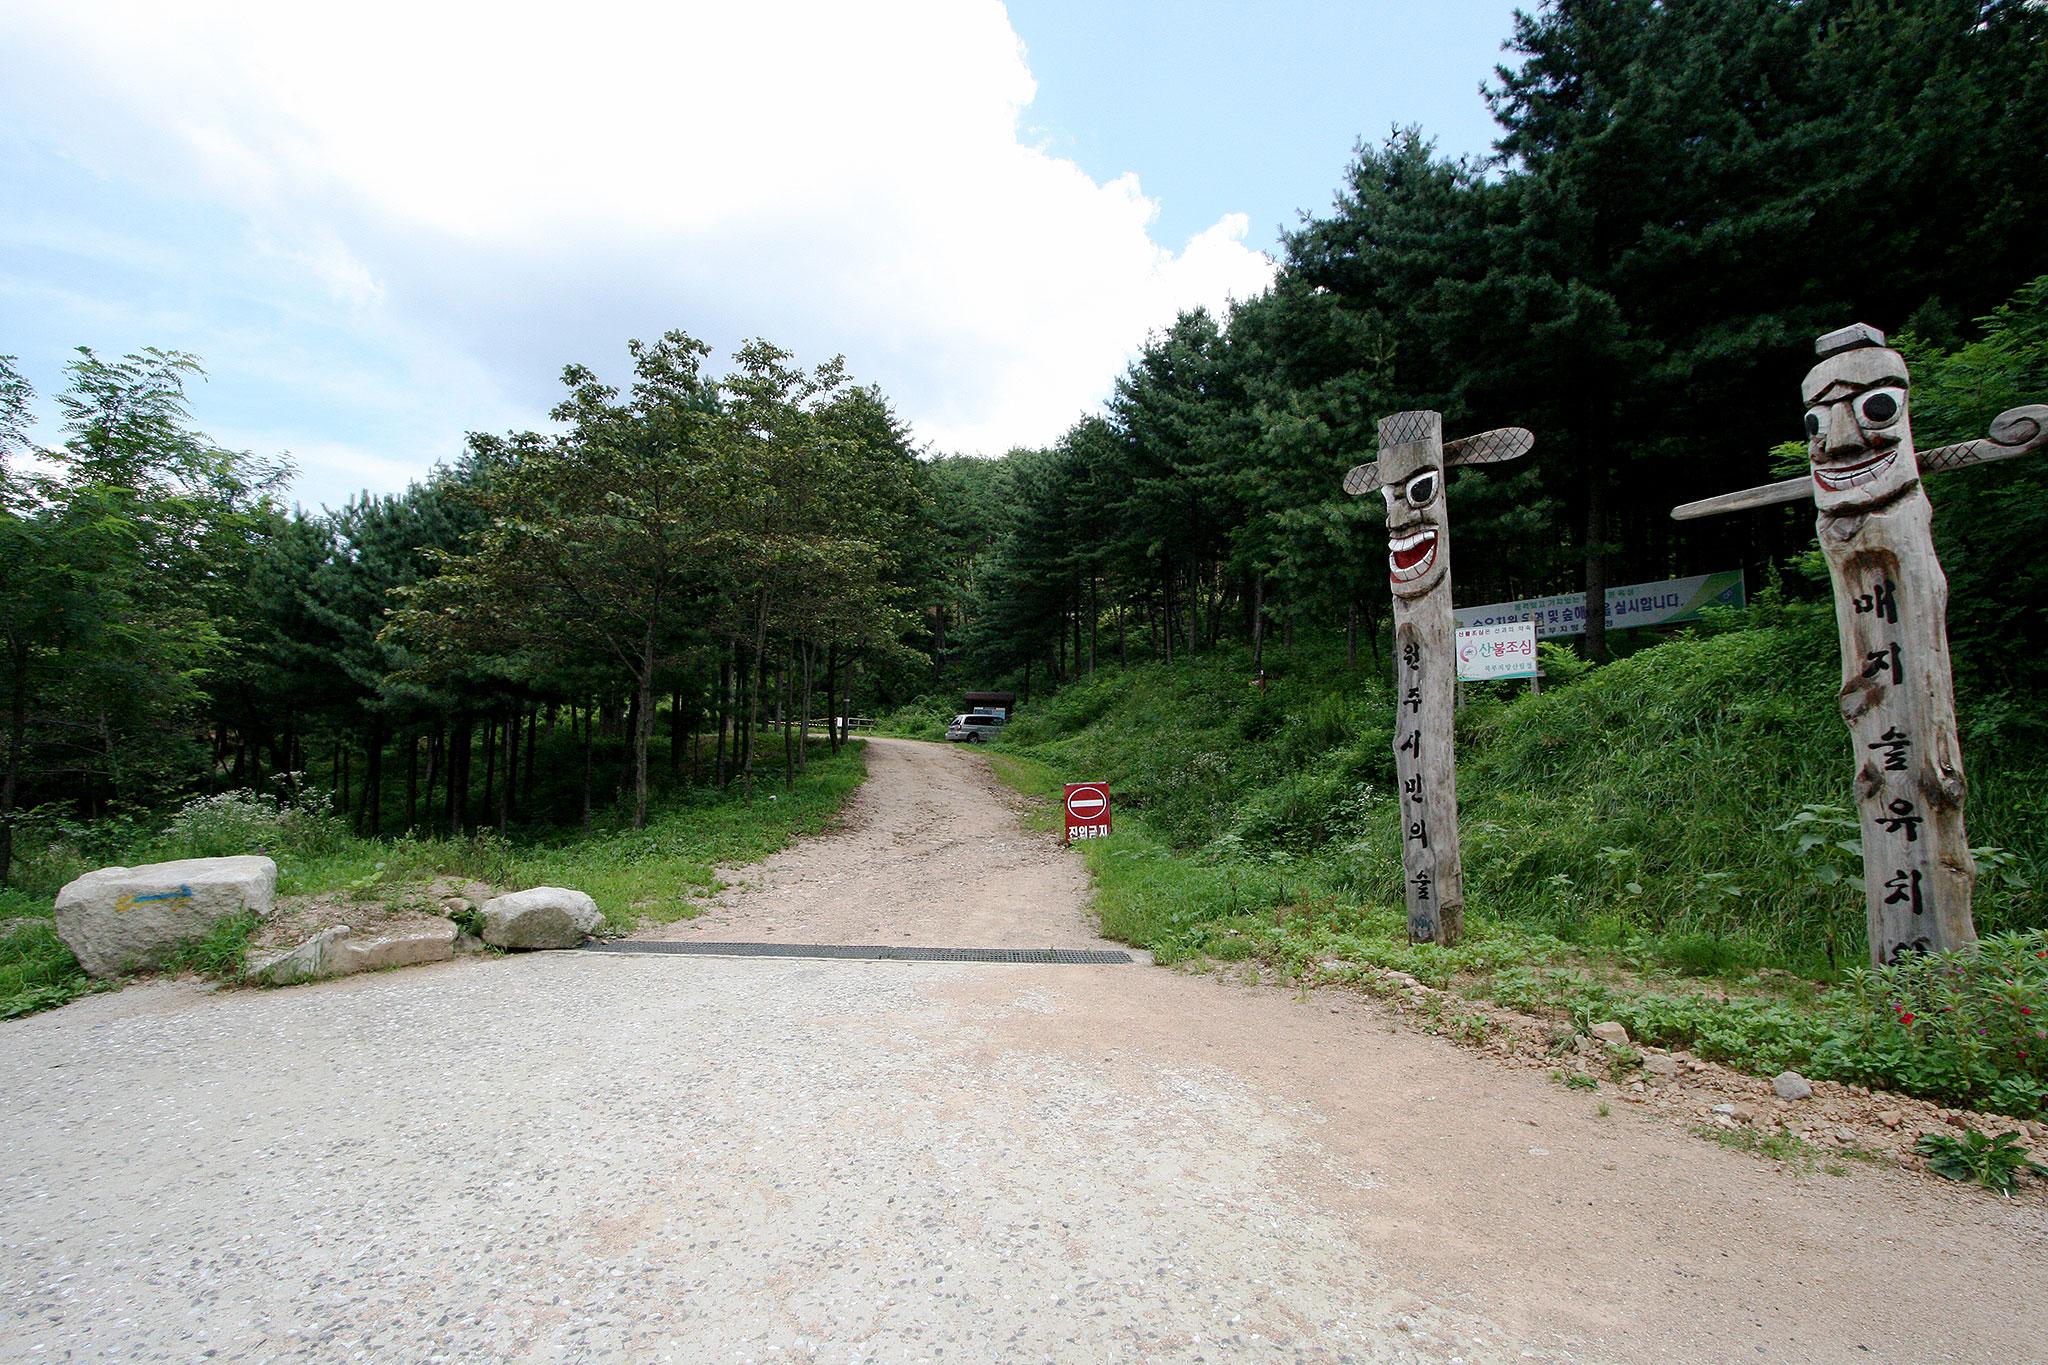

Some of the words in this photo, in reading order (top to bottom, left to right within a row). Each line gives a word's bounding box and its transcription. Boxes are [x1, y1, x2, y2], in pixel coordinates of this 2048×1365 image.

[1548, 609, 1559, 624] 및
[1615, 593, 1684, 615] 실시합니다.
[1478, 639, 1532, 658] 산불조심
[1068, 824, 1108, 840] 진입금지
